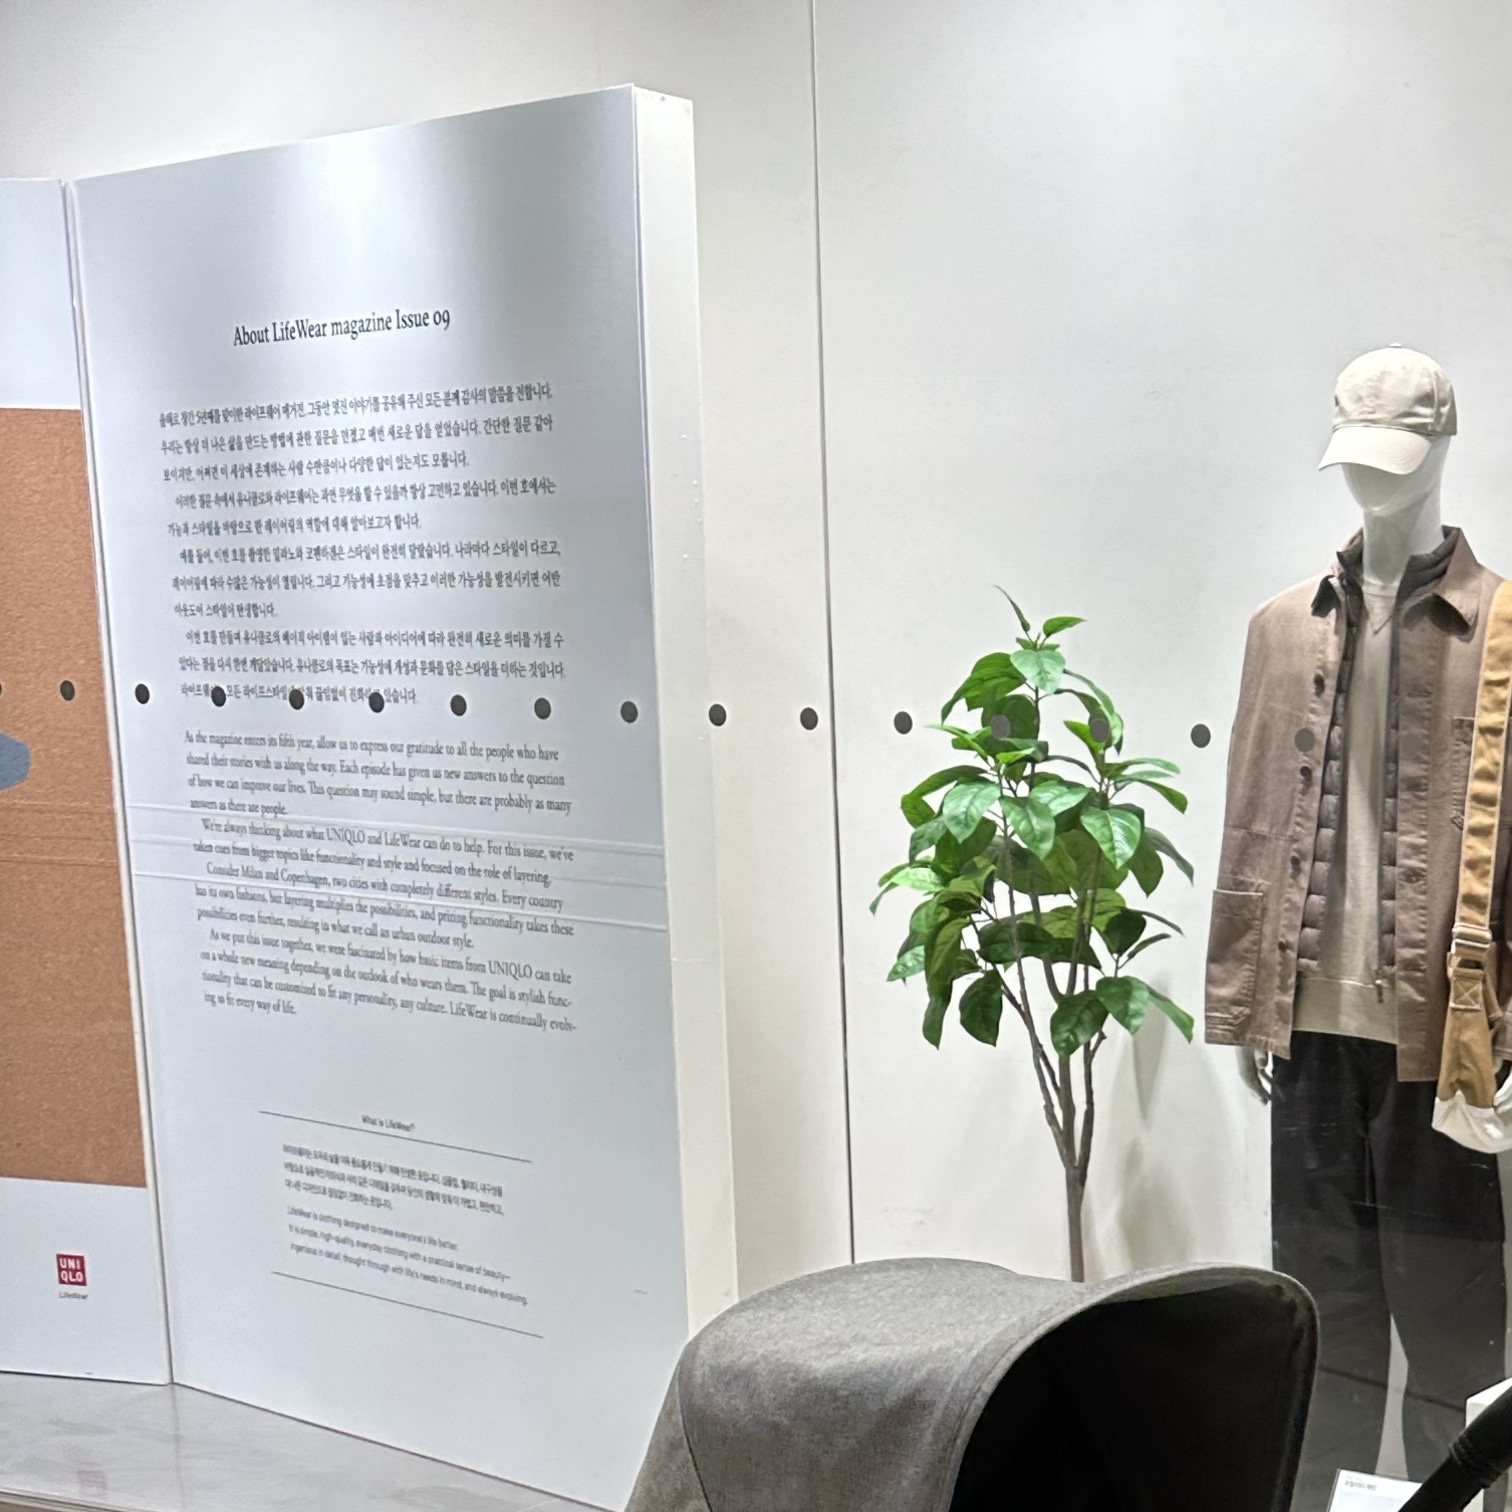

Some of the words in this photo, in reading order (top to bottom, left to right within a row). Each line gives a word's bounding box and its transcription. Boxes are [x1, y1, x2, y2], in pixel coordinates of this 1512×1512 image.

[233, 325, 269, 346] About
[273, 319, 327, 343] LifeWear
[331, 312, 392, 340] magazine
[395, 308, 429, 330] Issue
[433, 309, 450, 331] 09
[317, 735, 336, 749] allow
[406, 740, 443, 757] gratitude
[445, 745, 454, 755] to
[457, 741, 467, 755] all
[469, 741, 483, 756] the
[485, 743, 513, 762] people
[517, 744, 535, 759] who
[538, 744, 558, 760] have
[392, 761, 405, 776] has
[432, 769, 441, 778] us
[463, 771, 496, 781] answers
[498, 772, 507, 782] to
[510, 768, 523, 783] the
[526, 774, 564, 789] question
[380, 785, 404, 800] sound
[438, 788, 452, 803] but
[455, 789, 476, 805] there
[479, 796, 491, 805] are
[494, 792, 532, 813] probably
[535, 800, 543, 808] as
[546, 800, 571, 815] many
[326, 827, 365, 846] UNIQLO
[384, 831, 420, 848] LifeWear
[422, 840, 437, 849] can
[439, 836, 450, 850] do
[452, 841, 461, 851] to
[464, 838, 484, 857] help.
[487, 840, 501, 854] For
[504, 842, 520, 856] this
[549, 846, 573, 861] we've
[404, 858, 419, 871] and
[421, 857, 452, 874] focused
[454, 866, 465, 875] on
[468, 862, 481, 877] the
[484, 864, 500, 878] role
[502, 865, 512, 879] of
[436, 882, 471, 899] different
[473, 887, 498, 903] styles.
[501, 889, 526, 907] Every
[528, 896, 563, 911] country
[469, 911, 523, 934] functionality
[526, 917, 548, 932] takes
[551, 920, 573, 935] these
[418, 930, 450, 945] outdoor
[452, 933, 474, 950] style.
[465, 956, 486, 972] from
[488, 960, 532, 980] UNIQLO
[535, 970, 549, 981] can
[553, 968, 571, 984] take
[470, 980, 486, 996] The
[489, 984, 506, 1001] goal
[509, 990, 515, 1000] is
[518, 988, 545, 1005] stylish
[449, 1001, 487, 1019] LifeWear
[490, 1008, 496, 1020] is
[58, 1257, 81, 1270] UNI
[60, 1270, 84, 1284] QLO
